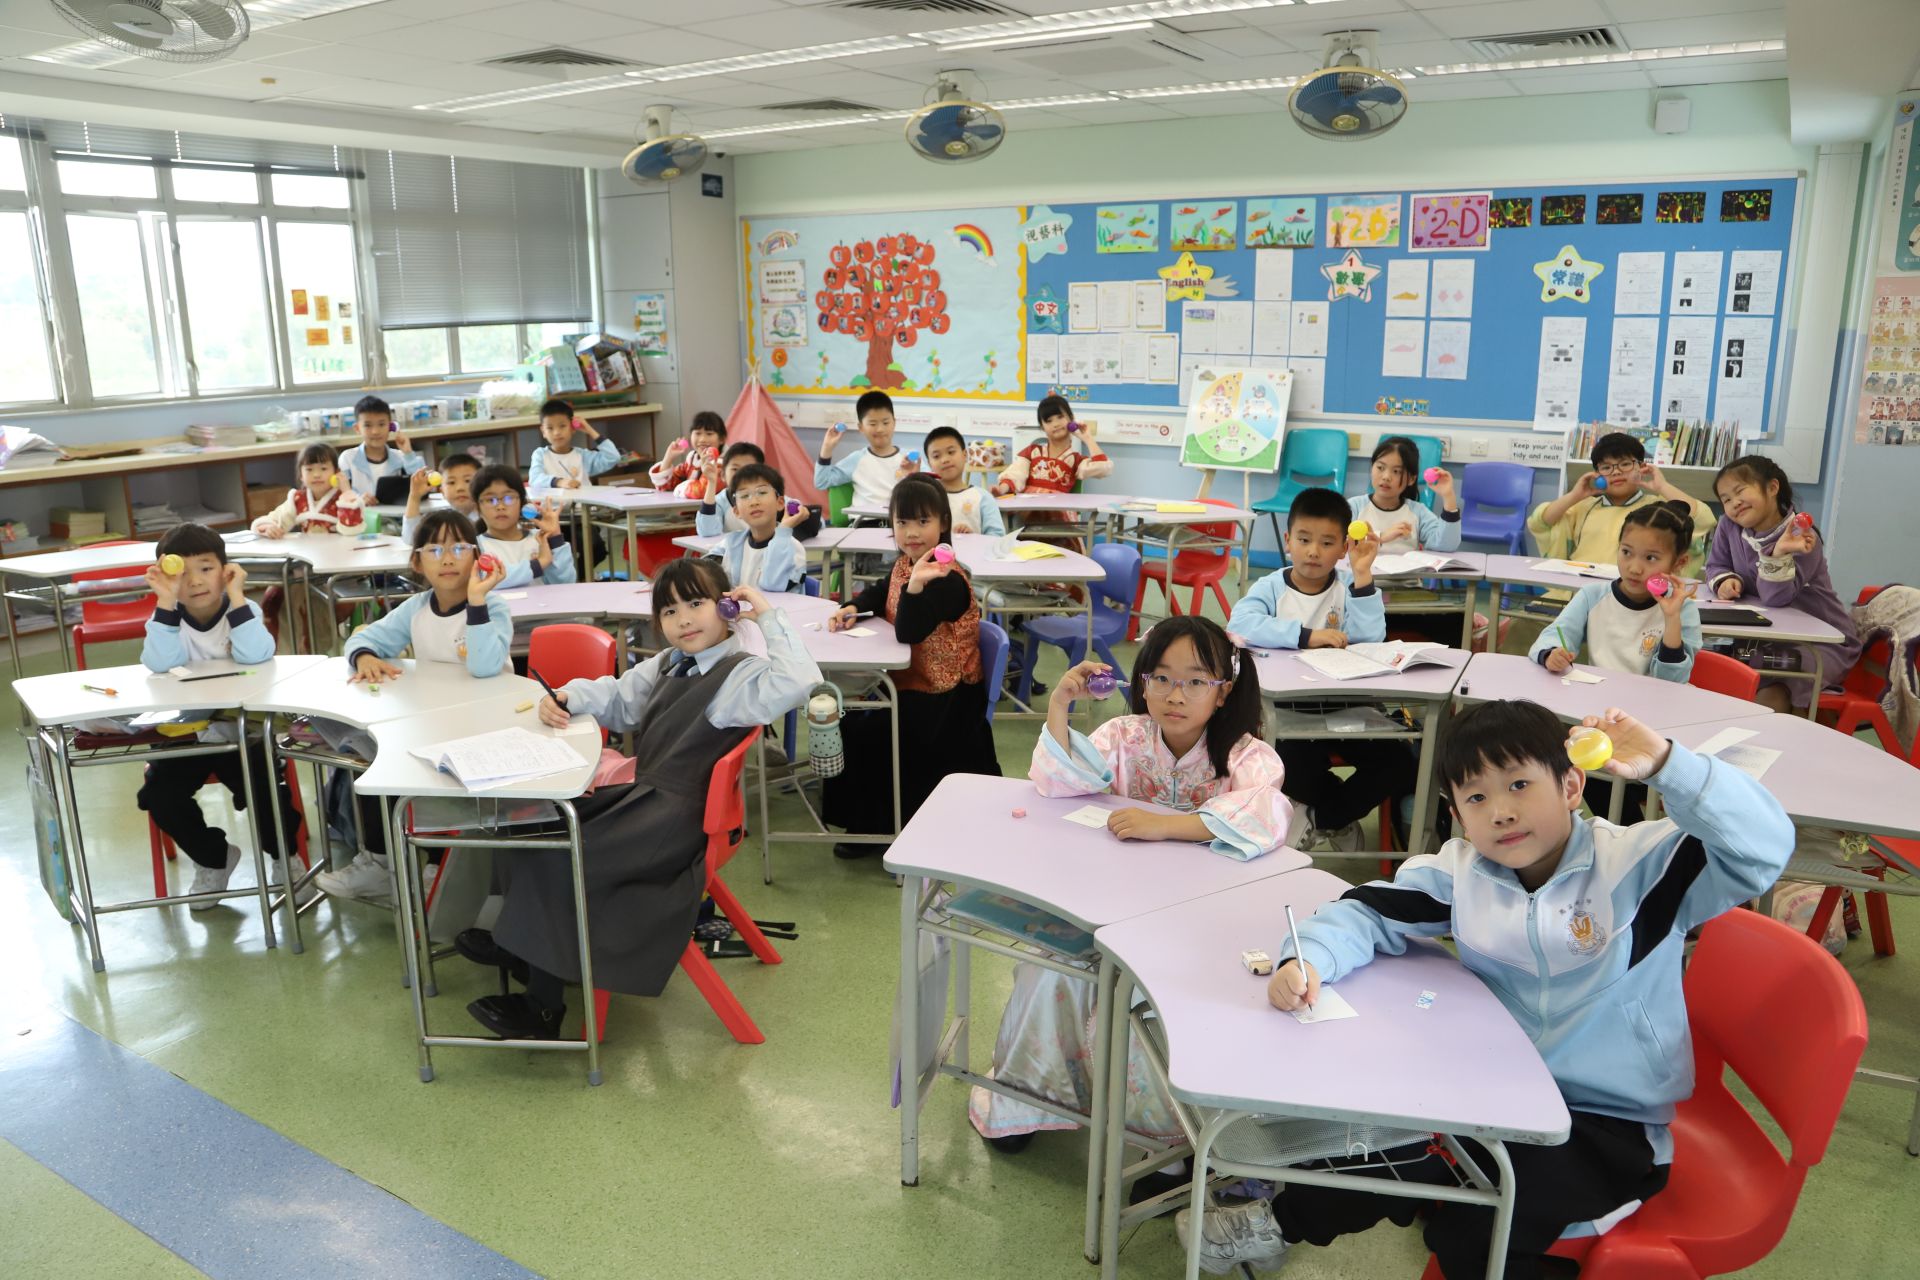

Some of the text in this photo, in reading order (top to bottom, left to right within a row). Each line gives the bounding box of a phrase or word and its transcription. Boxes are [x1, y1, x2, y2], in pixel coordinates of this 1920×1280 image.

[1165, 278, 1204, 288] English
[1034, 301, 1057, 315] 中文
[1513, 442, 1530, 450] Keep
[1513, 452, 1526, 461] tidy
